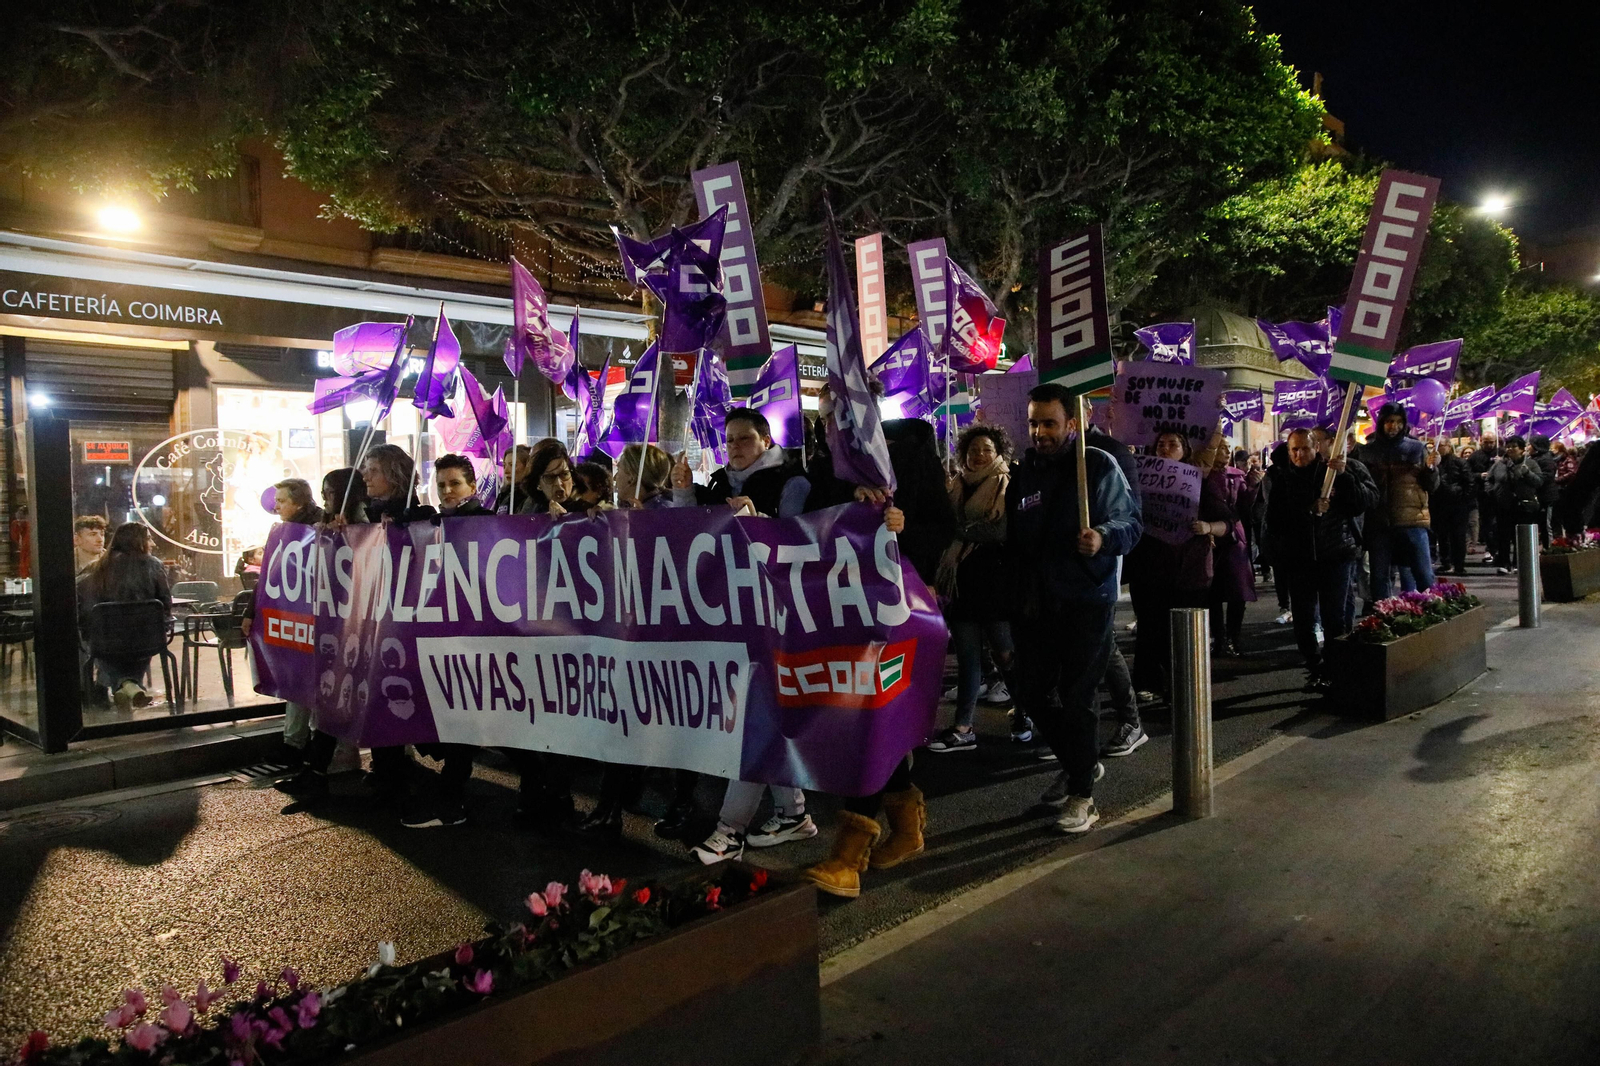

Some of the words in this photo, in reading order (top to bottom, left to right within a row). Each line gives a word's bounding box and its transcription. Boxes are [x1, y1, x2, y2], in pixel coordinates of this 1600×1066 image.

[1350, 181, 1427, 340] CCOO
[2, 289, 122, 316] CAFETERÍA
[128, 301, 223, 326] COIMBRA
[915, 247, 947, 345] CCO
[1050, 234, 1096, 360] CCOO
[1125, 391, 1141, 404] DE
[1158, 392, 1190, 405] ALAS
[1127, 376, 1155, 391] SOY
[1157, 377, 1204, 392] MUJER
[1143, 405, 1163, 419] NO
[1168, 406, 1186, 419] DE
[156, 441, 190, 472] Café
[1136, 455, 1165, 472] SMO
[184, 527, 220, 547] Año
[429, 652, 535, 725] VIVAS,
[535, 652, 629, 737] LIBRES,
[626, 659, 739, 734] UNIDAS
[777, 661, 877, 696] CCOO
